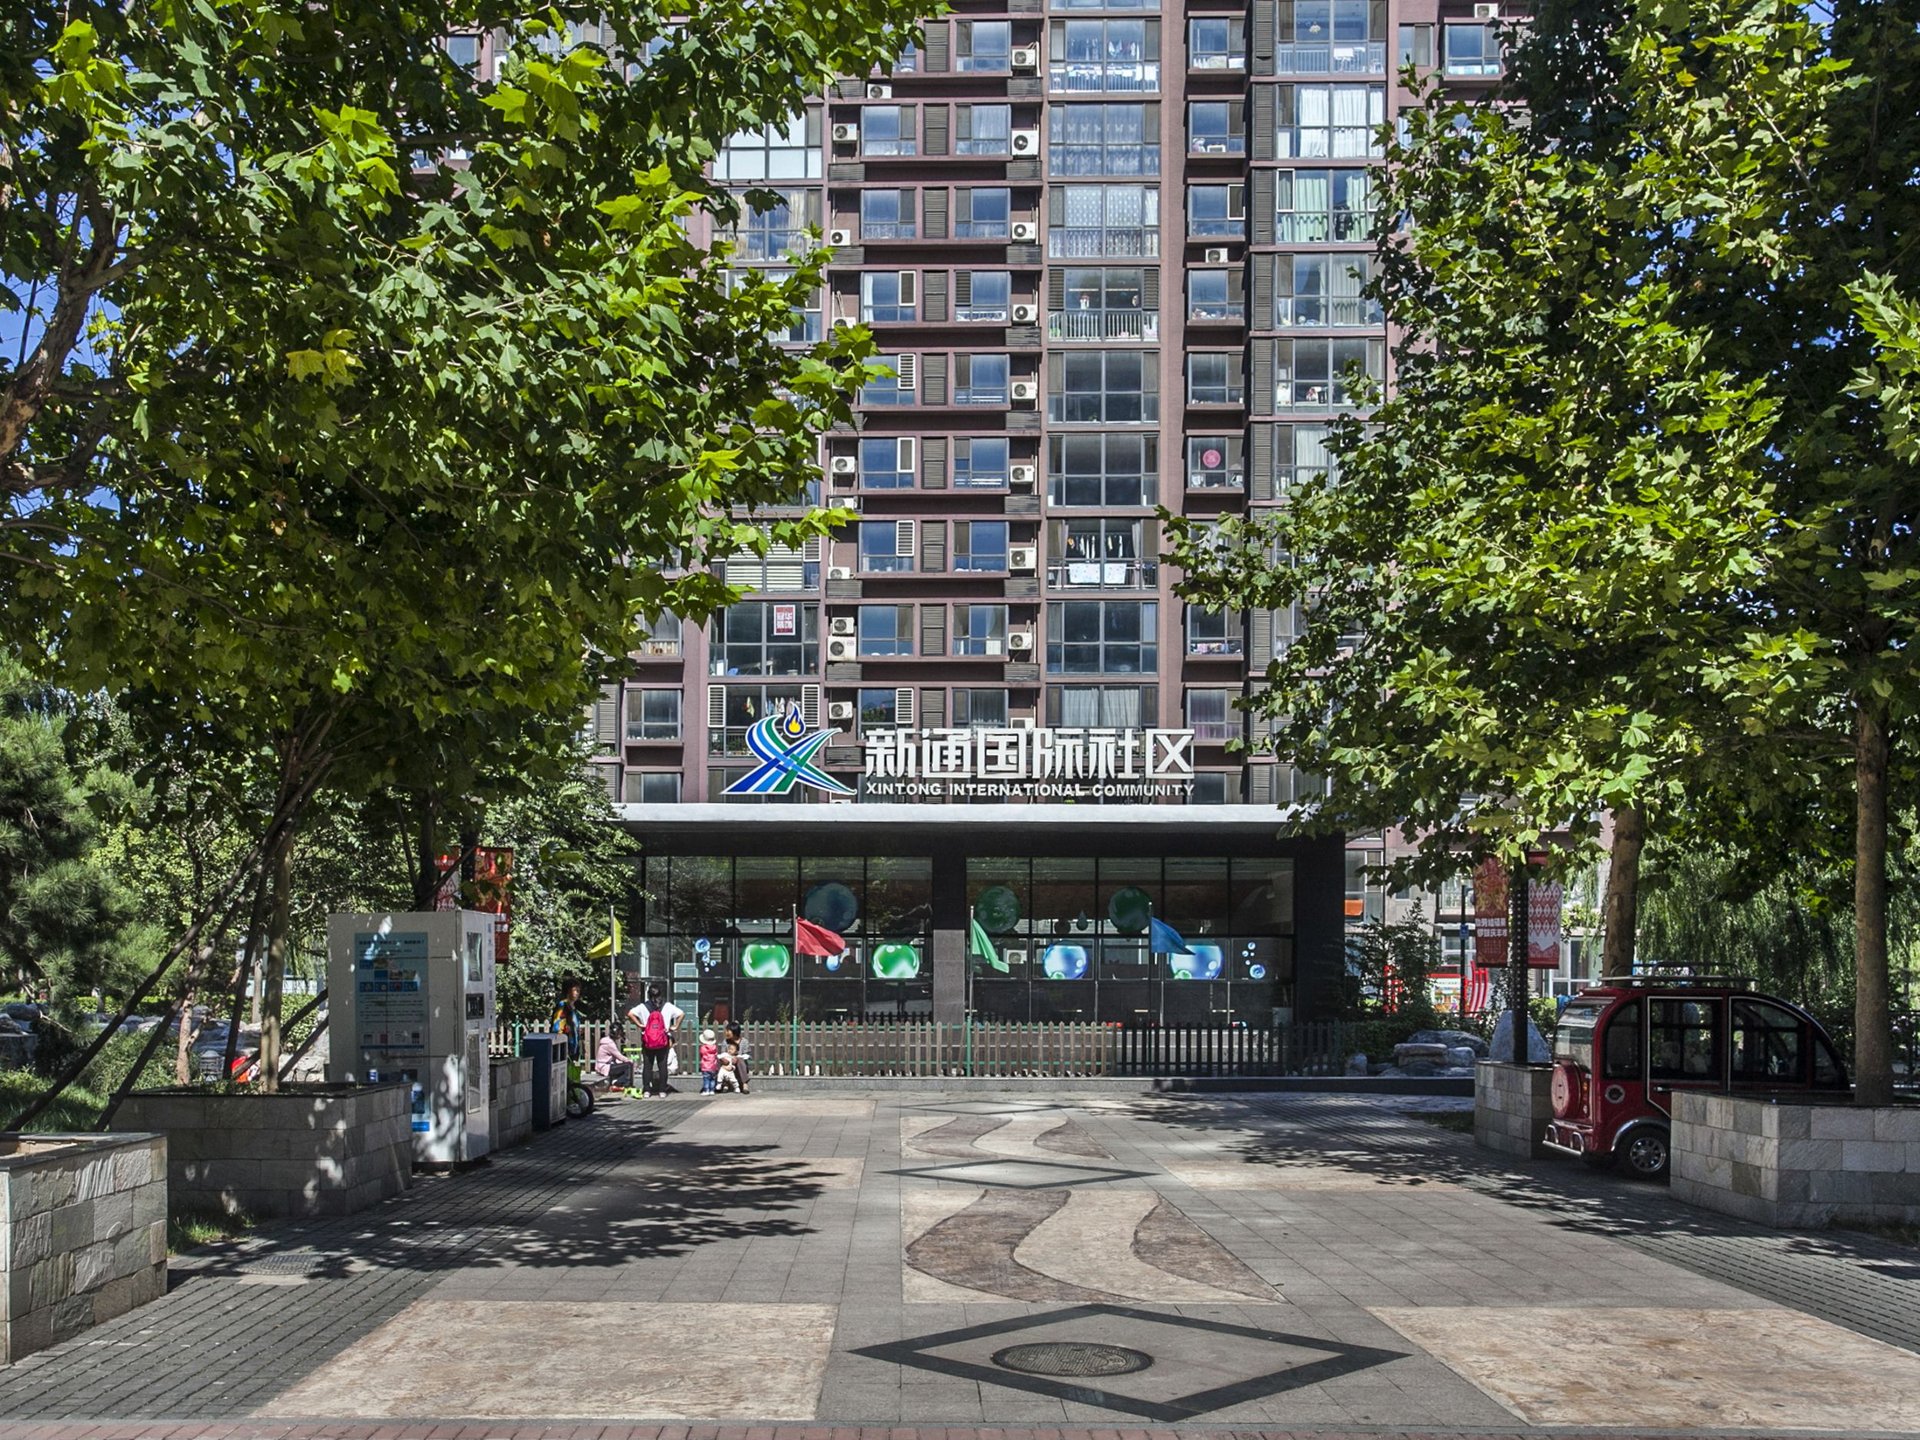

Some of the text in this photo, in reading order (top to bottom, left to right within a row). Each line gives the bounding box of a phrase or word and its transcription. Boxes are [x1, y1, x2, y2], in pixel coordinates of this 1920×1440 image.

[865, 728, 1195, 779] 新通国际社区
[866, 782, 1195, 797] XINTONG INTERNATIONAL COMMUNITY
